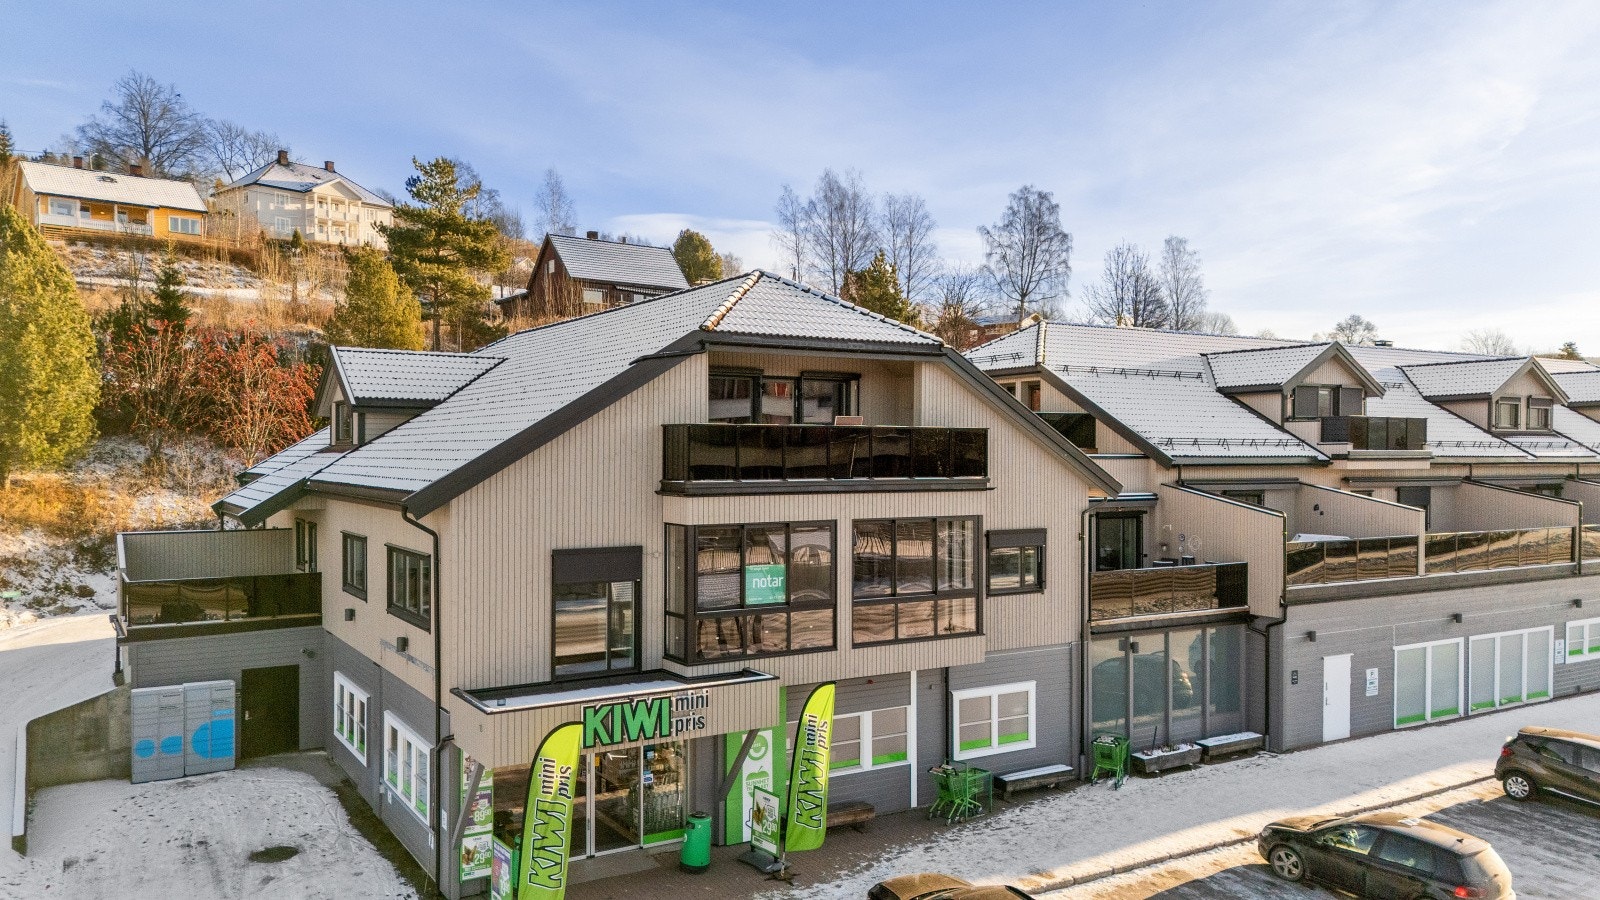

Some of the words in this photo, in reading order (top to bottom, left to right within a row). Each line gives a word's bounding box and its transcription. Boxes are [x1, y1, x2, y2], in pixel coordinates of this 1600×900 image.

[752, 574, 784, 589] notar
[675, 690, 709, 711] mini
[582, 695, 672, 748] KIWI
[675, 712, 705, 737] pris
[805, 714, 818, 746] mini
[817, 720, 829, 750] pris
[538, 757, 556, 796] mini
[556, 765, 572, 800] pris
[795, 749, 825, 829] KIWI
[528, 798, 568, 890] KIWI
